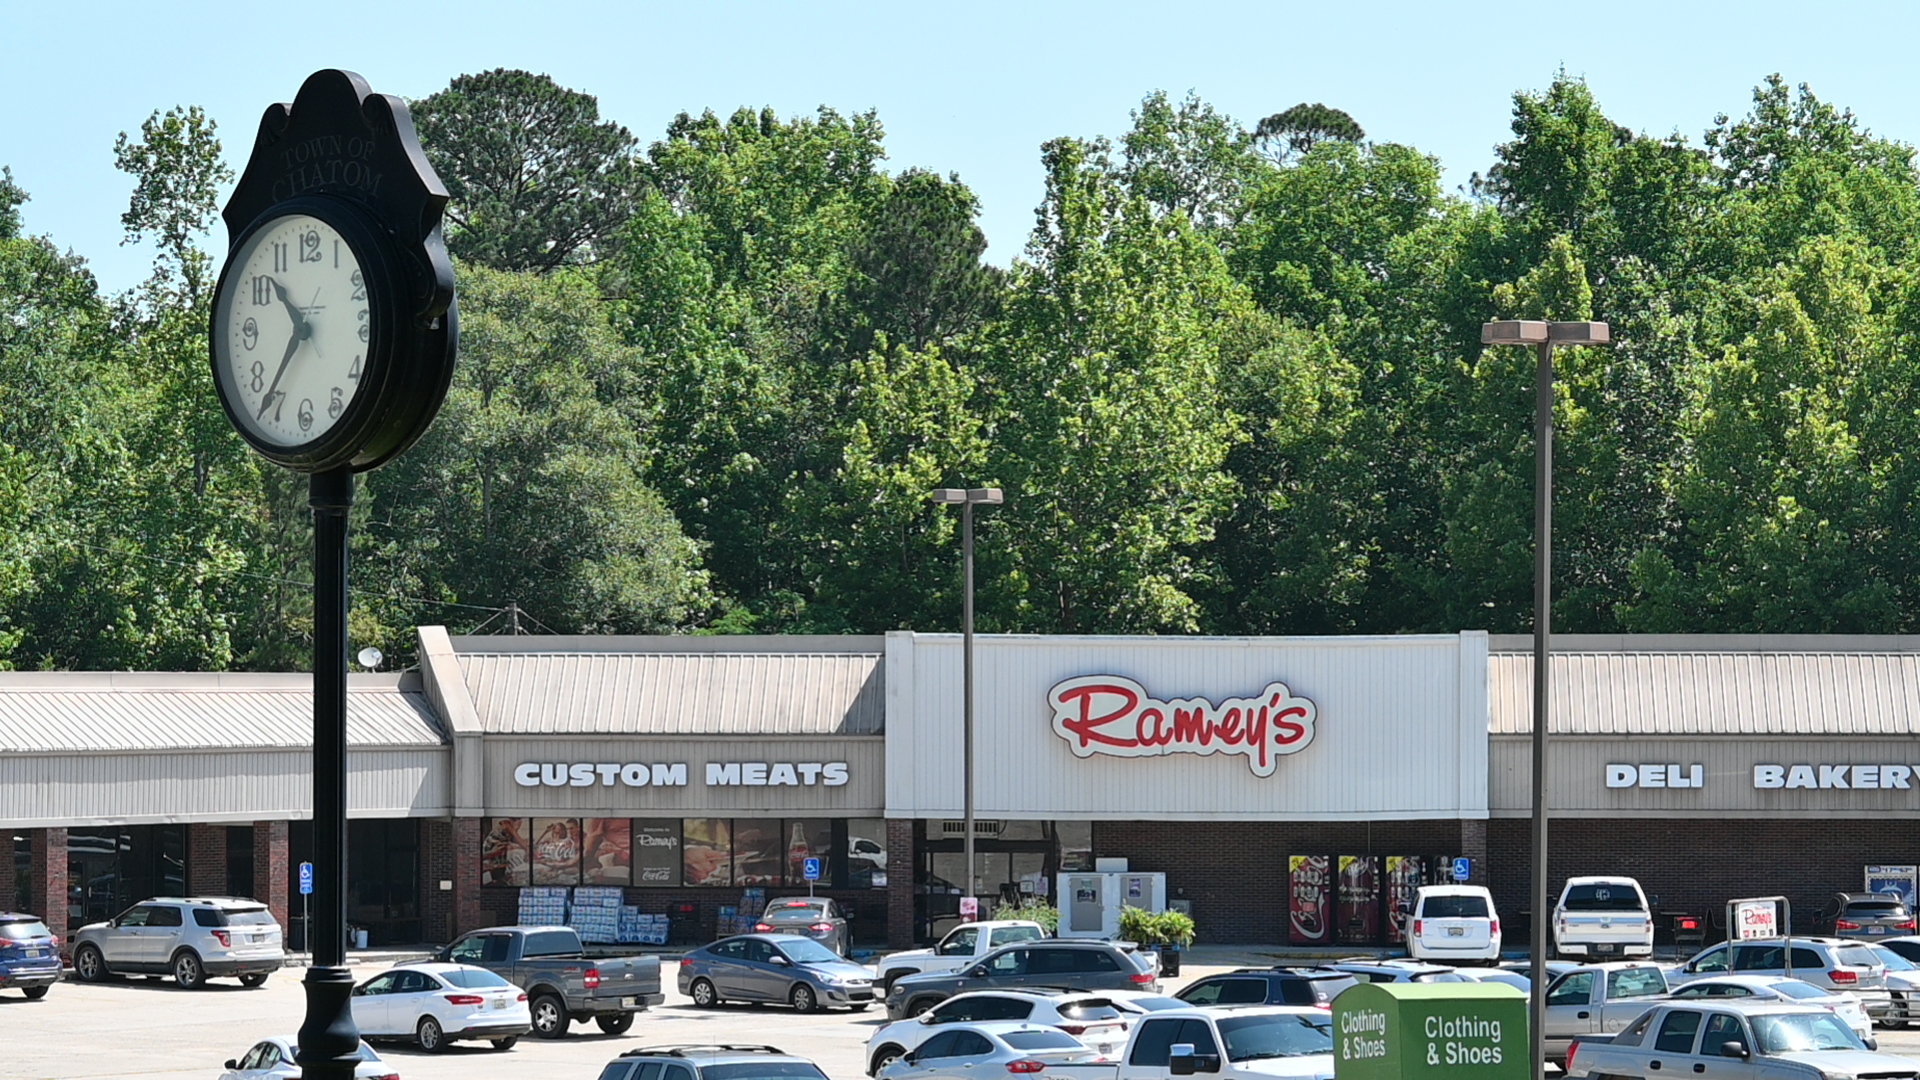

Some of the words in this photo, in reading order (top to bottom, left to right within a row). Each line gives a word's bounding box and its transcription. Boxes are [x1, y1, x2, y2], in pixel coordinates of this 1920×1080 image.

[280, 134, 342, 170] TOWN
[347, 136, 376, 162] OF
[272, 159, 384, 205] CHATOM
[274, 242, 288, 273] 11
[299, 230, 323, 264] 12
[333, 239, 339, 269] 1
[252, 274, 272, 306] 10
[350, 268, 367, 302] 2
[242, 316, 259, 351] 9
[250, 360, 265, 393] 8
[347, 354, 362, 385] 4
[271, 389, 287, 423] 7
[297, 398, 315, 432] 6
[327, 386, 344, 419] 5
[1057, 683, 1307, 768] Ramey's
[514, 762, 688, 787] CUSTOM
[705, 762, 849, 786] MEATS
[1605, 764, 1704, 789] DELI
[1753, 765, 1920, 789] BAKER
[1340, 1008, 1386, 1036] Clothing
[1425, 1015, 1502, 1043] Clothing
[1342, 1037, 1352, 1061] &
[1353, 1036, 1386, 1060] Shoes
[1426, 1042, 1440, 1066] &
[1445, 1041, 1503, 1065] Shoes
